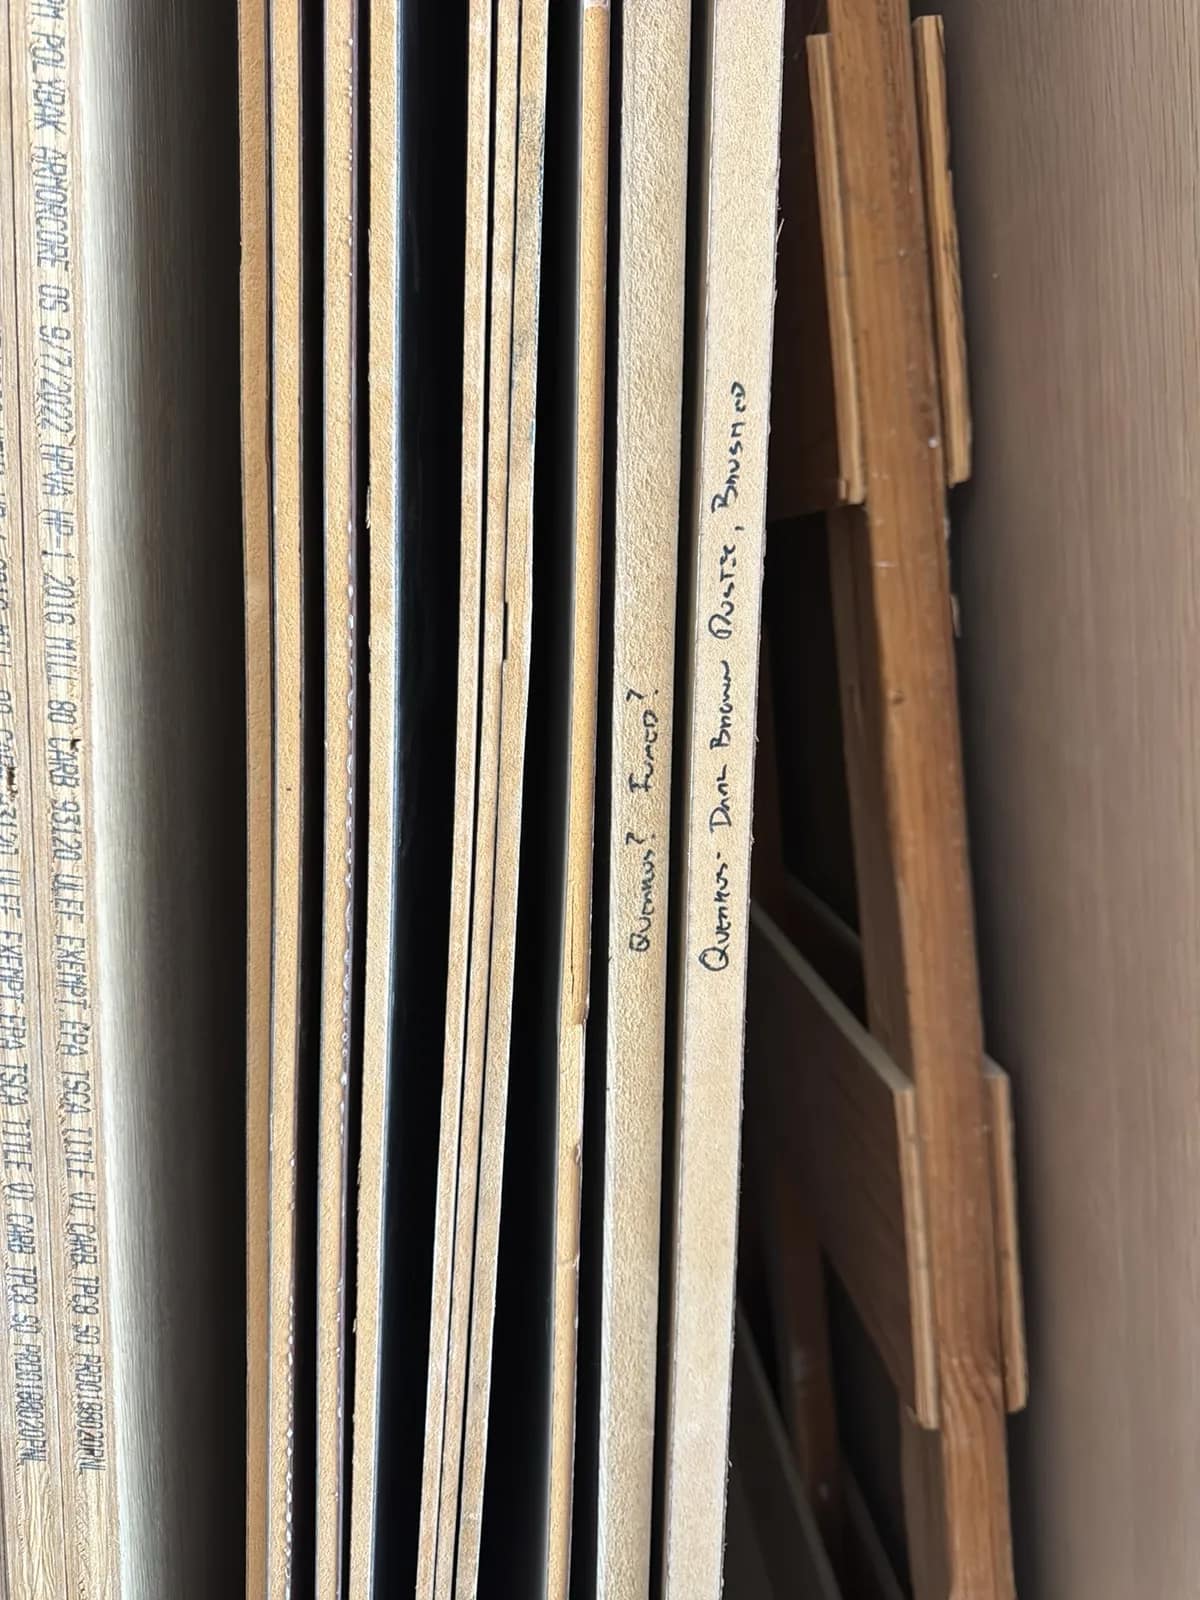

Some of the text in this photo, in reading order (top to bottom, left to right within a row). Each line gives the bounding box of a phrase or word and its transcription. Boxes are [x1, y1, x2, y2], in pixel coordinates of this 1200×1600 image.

[34, 147, 69, 272] ARMORCORE
[39, 326, 73, 433] 9/7/2022
[41, 444, 74, 497] HPVA
[40, 510, 75, 558] HP-1
[43, 573, 77, 626] 2016
[45, 636, 79, 686] MILL
[48, 737, 81, 788] CARB
[51, 800, 82, 861] 93120
[59, 1020, 90, 1056] EPA
[0, 1064, 29, 1106] TSCA
[61, 1070, 92, 1114] TSCA
[3, 1120, 32, 1172] TITLE
[65, 1128, 95, 1181] TITLE
[7, 1214, 36, 1255] CARB
[68, 1223, 98, 1265] CARB
